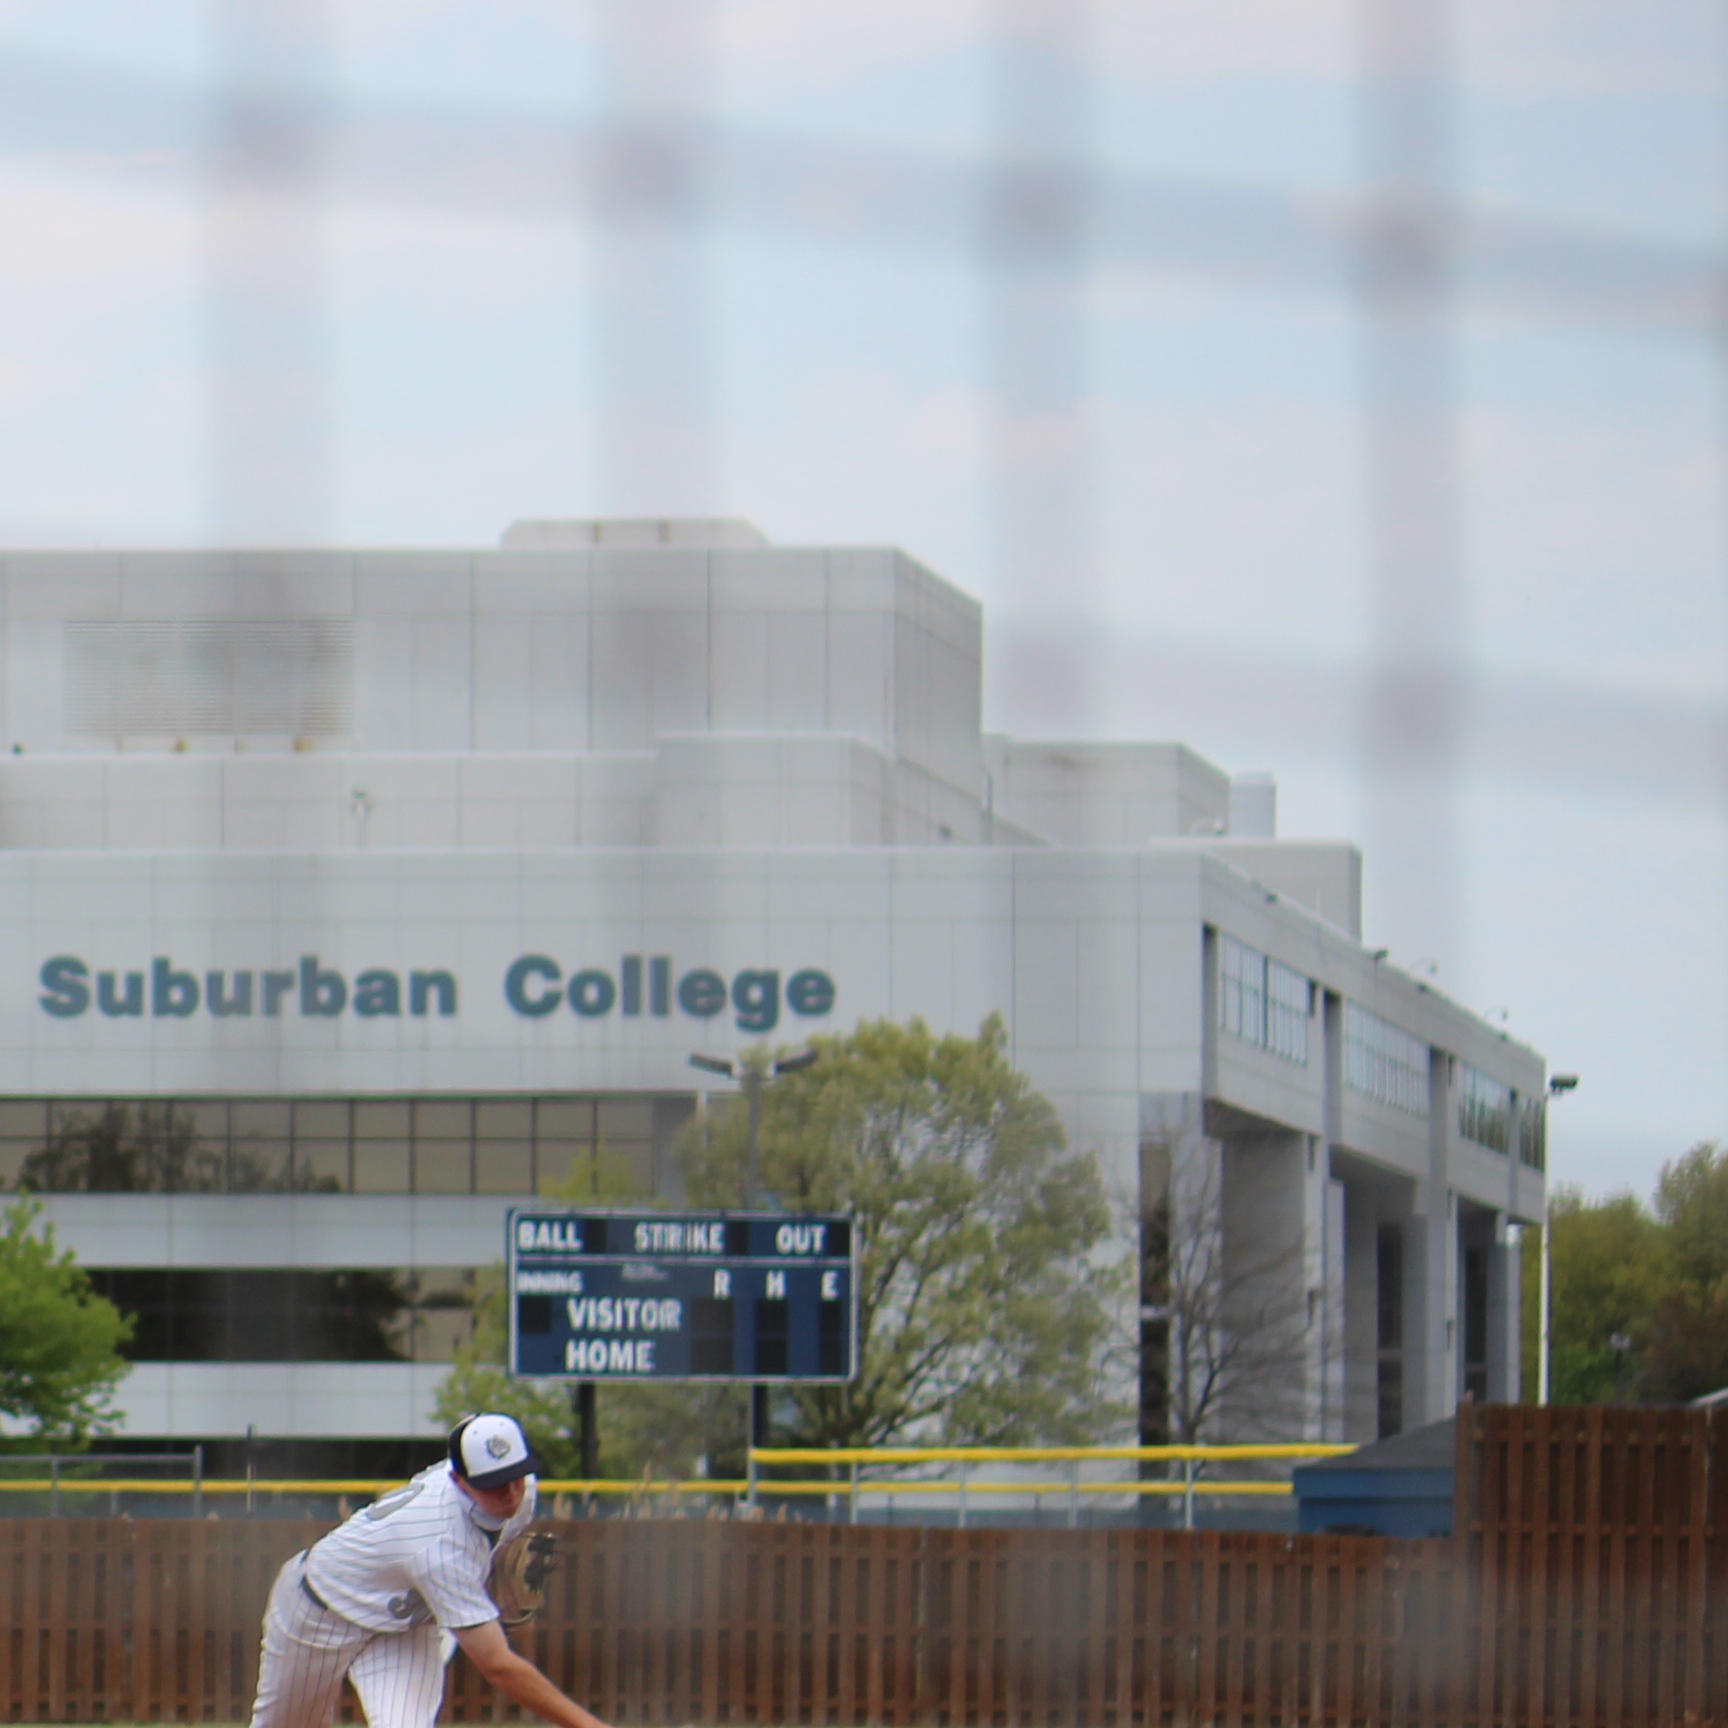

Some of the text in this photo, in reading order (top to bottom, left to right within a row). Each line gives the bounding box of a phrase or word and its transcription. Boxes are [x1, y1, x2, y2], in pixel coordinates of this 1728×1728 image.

[39, 953, 458, 1018] Suburban
[504, 953, 836, 1033] College
[518, 1220, 826, 1254] BALL STRIKE OUT
[517, 1269, 839, 1301] INNING R H E
[566, 1298, 682, 1331] VISITOR
[565, 1340, 656, 1372] HOME
